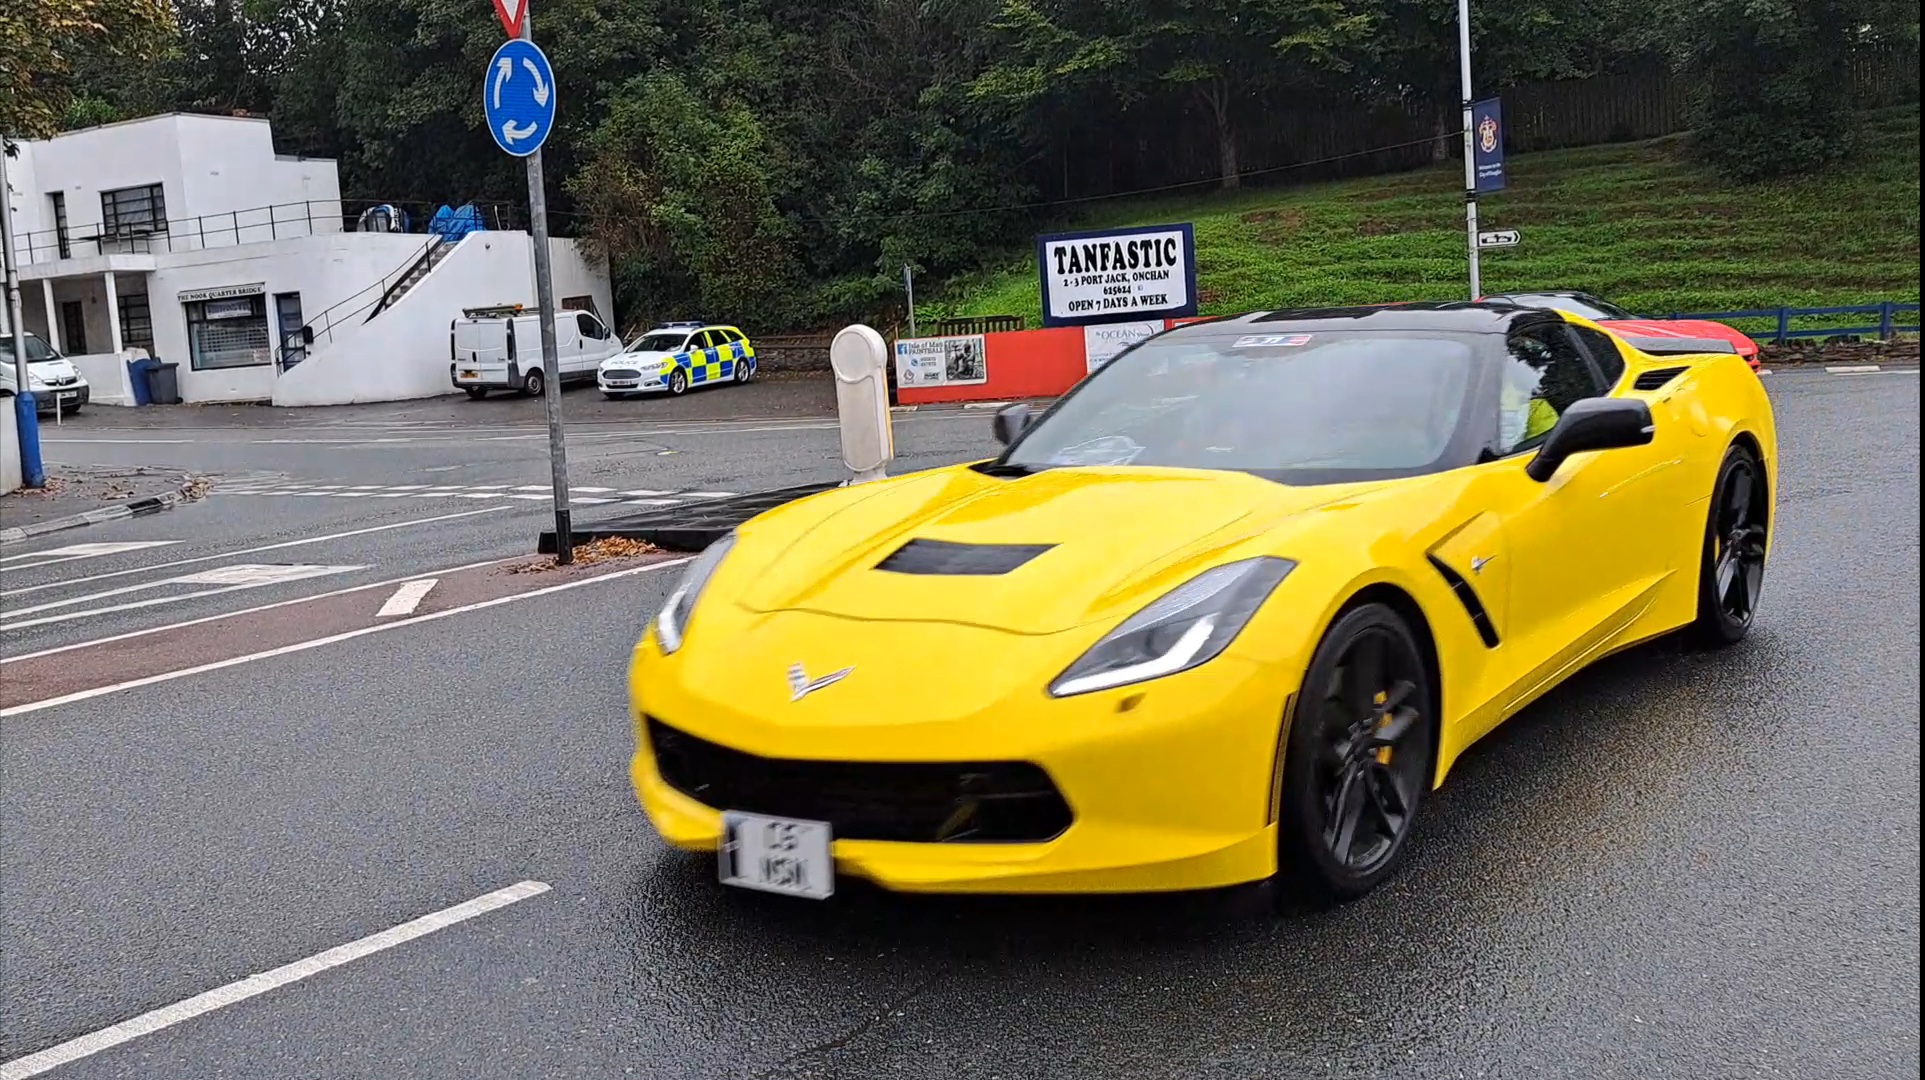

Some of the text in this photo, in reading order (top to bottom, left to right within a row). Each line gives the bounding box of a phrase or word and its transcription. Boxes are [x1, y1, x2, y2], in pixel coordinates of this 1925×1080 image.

[1054, 238, 1177, 274] TANFASTIC
[1081, 274, 1104, 286] PORT
[1105, 273, 1131, 284] JACK,
[1132, 270, 1170, 281] ONCHAN
[208, 289, 237, 299] QUARTER
[238, 287, 261, 295] BRIDGE
[1068, 294, 1169, 312] OPEN 7 DAYS A WEEK
[1101, 329, 1136, 340] OCEAN
